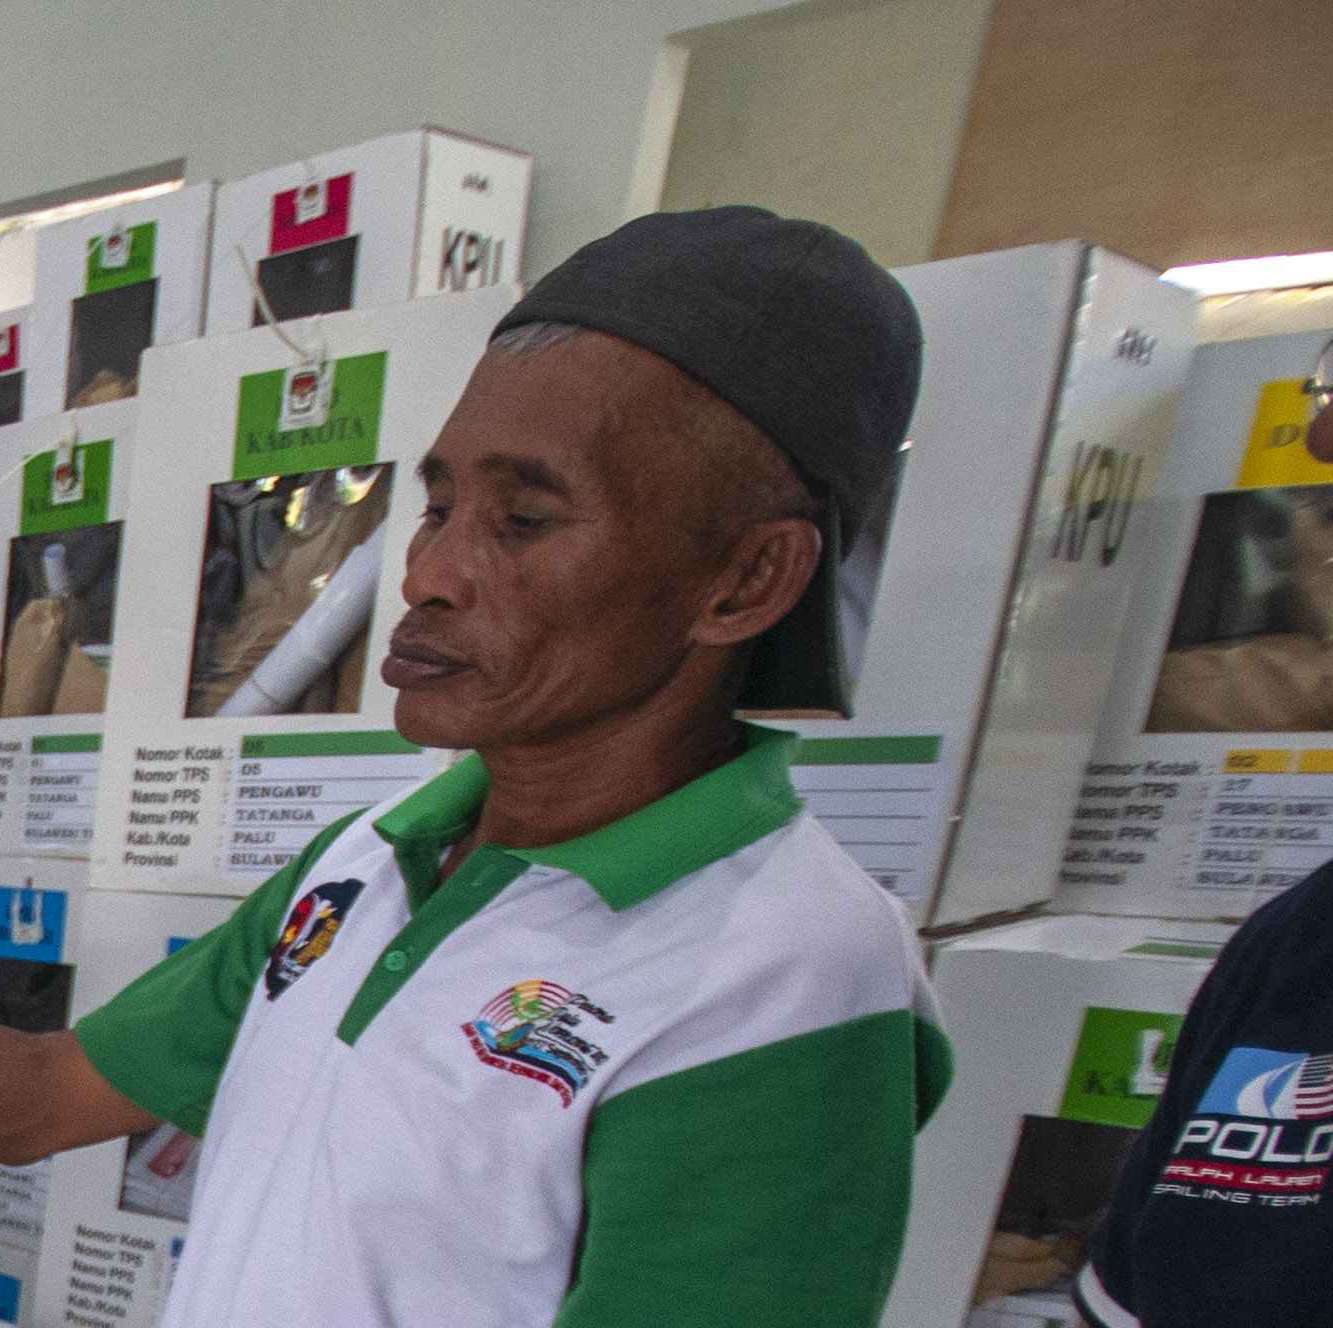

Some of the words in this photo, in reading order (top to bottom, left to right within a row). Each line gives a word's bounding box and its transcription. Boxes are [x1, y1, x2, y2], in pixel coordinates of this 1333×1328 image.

[135, 747, 181, 761] Nomor
[134, 768, 178, 783] Nomor
[182, 766, 210, 782] TPS
[131, 789, 169, 803] Nama
[172, 788, 201, 804] PPS
[238, 785, 323, 799] PENGAWU
[129, 810, 167, 824] Nama
[169, 810, 199, 824] PPK
[236, 809, 315, 821] TATANGA
[233, 831, 275, 844] PALU
[124, 851, 179, 867] Provinsi
[231, 854, 299, 866] SULAW
[1173, 1119, 1333, 1163] POLO
[1152, 1182, 1253, 1204] SAILING
[1257, 1193, 1321, 1207] TEAM
